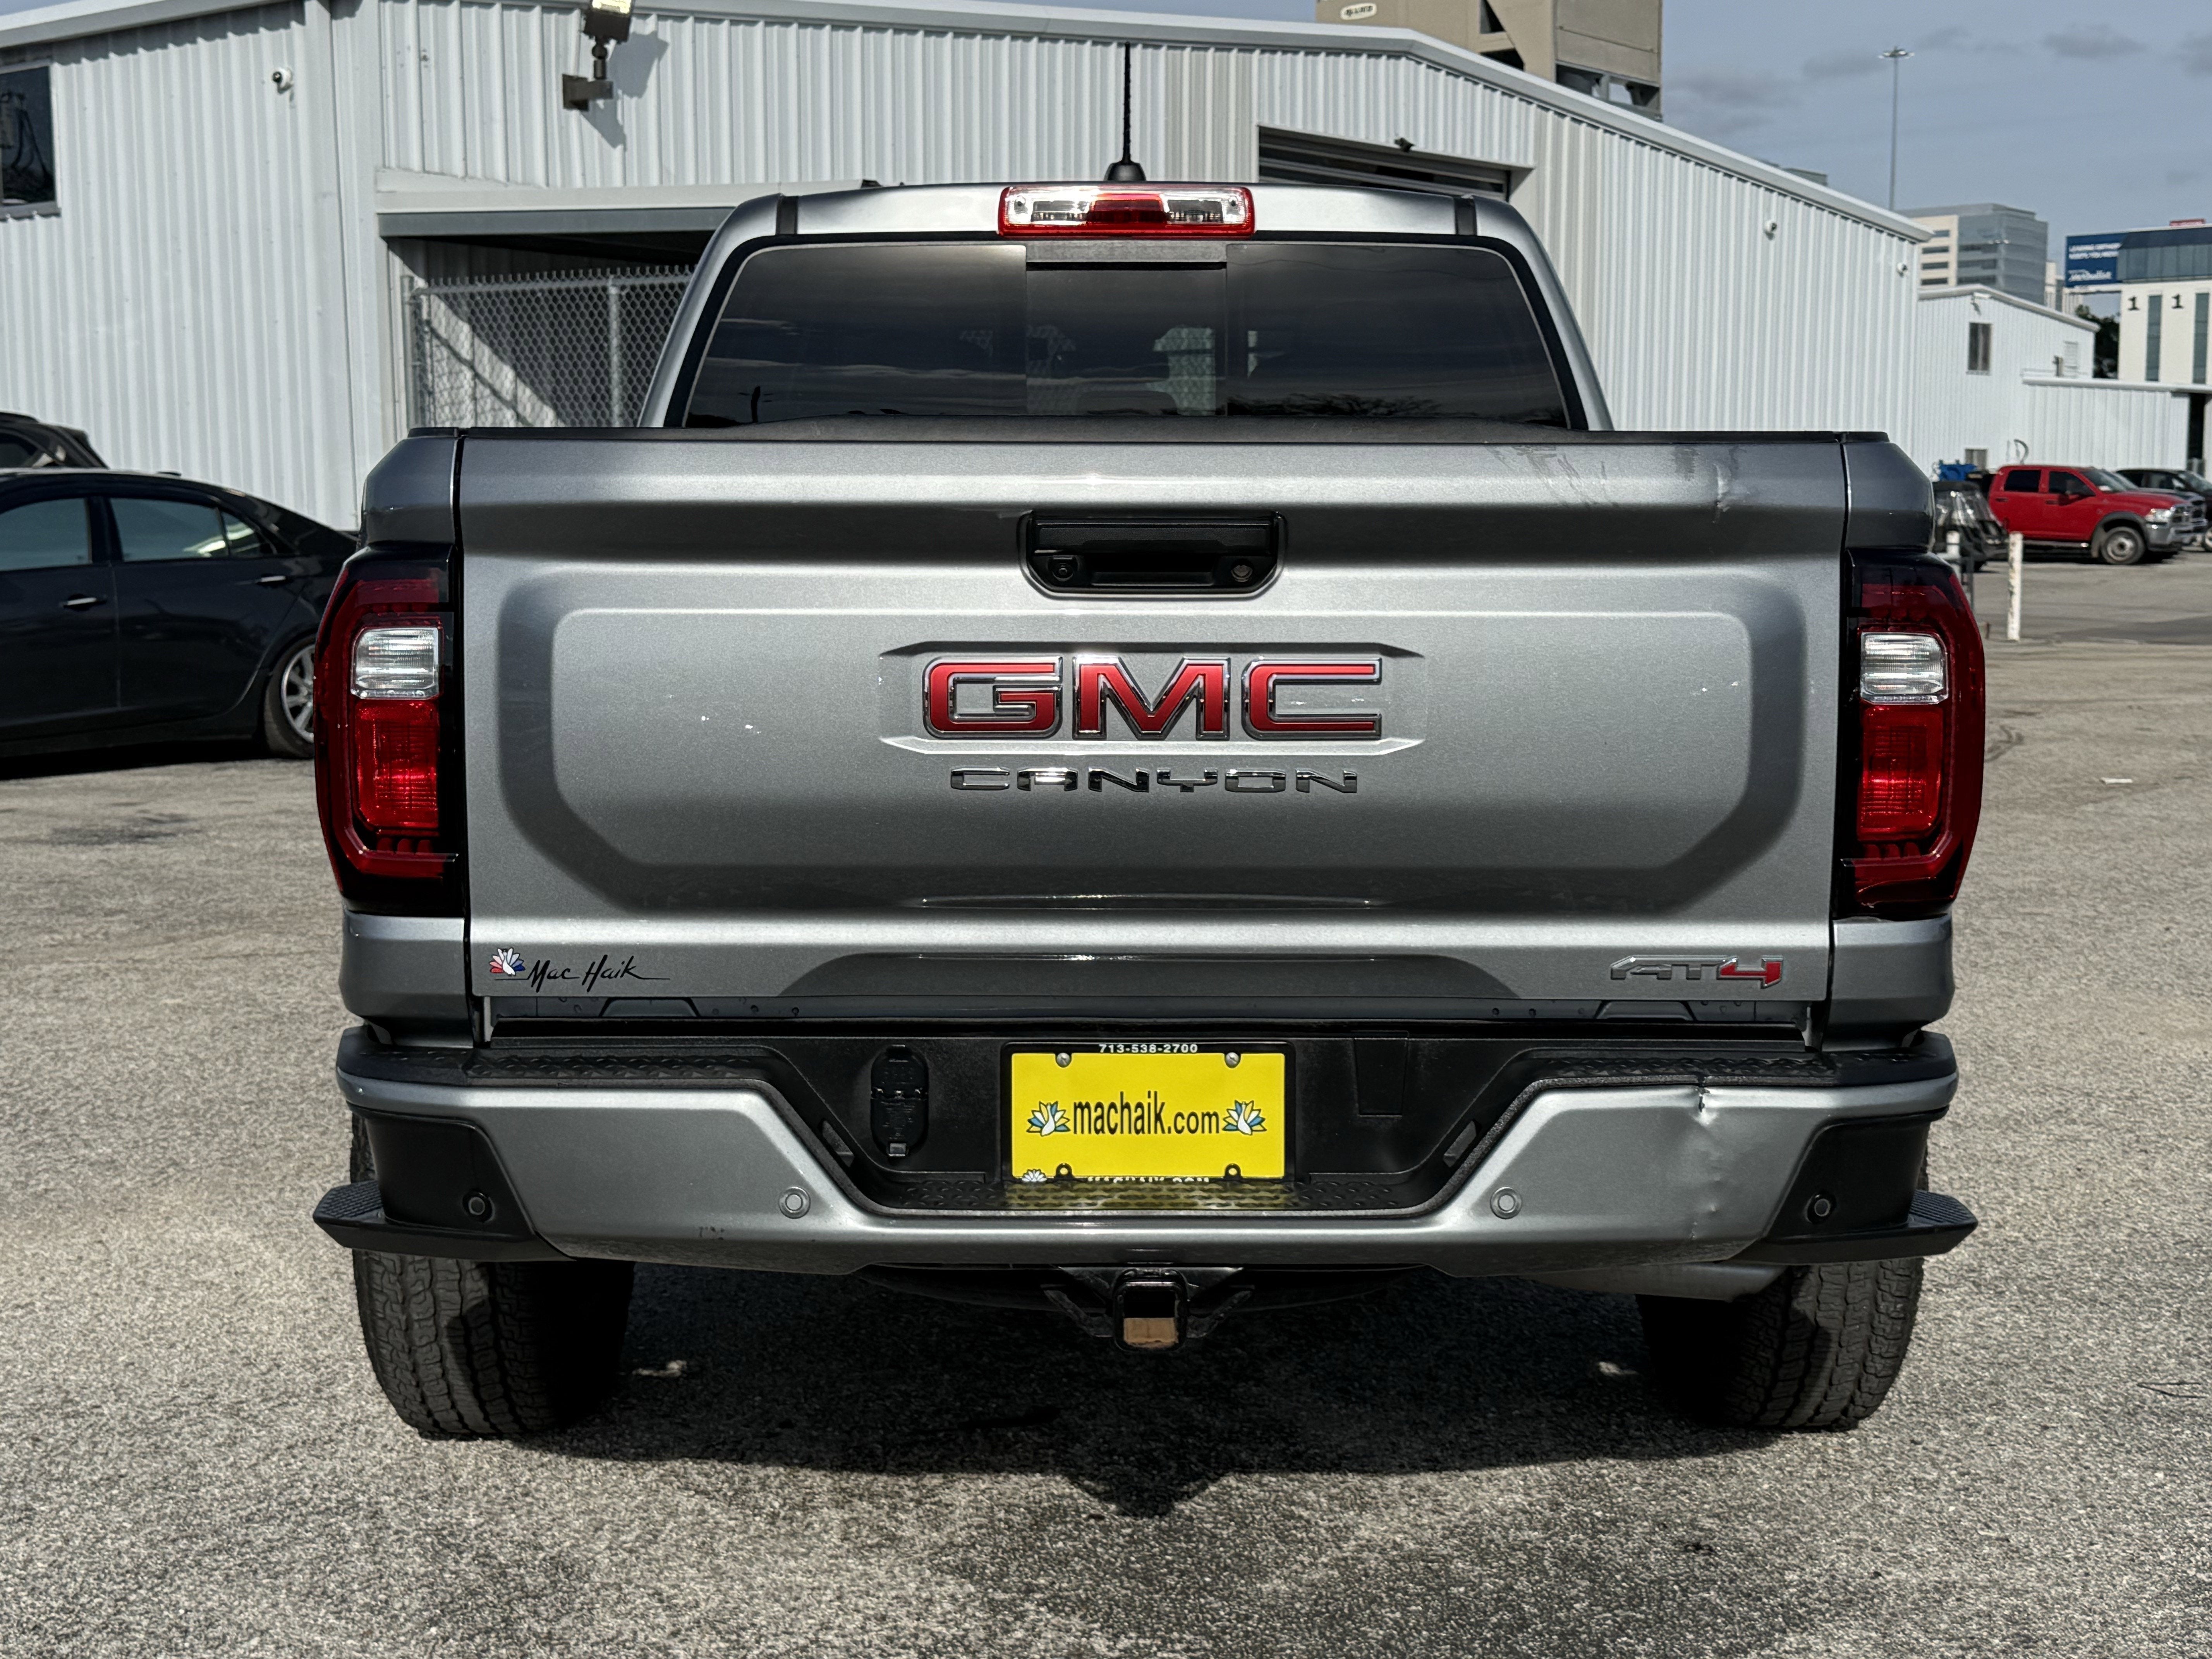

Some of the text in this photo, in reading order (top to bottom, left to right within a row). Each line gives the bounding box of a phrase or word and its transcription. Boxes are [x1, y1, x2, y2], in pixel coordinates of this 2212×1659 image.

[922, 656, 1382, 740] GMC
[950, 767, 1357, 792] CANYON
[527, 954, 670, 993] Mac Haik
[1610, 955, 1783, 989] AT4
[1098, 1044, 1198, 1053] 713-538-2700
[1073, 1091, 1219, 1135] machaik.com
